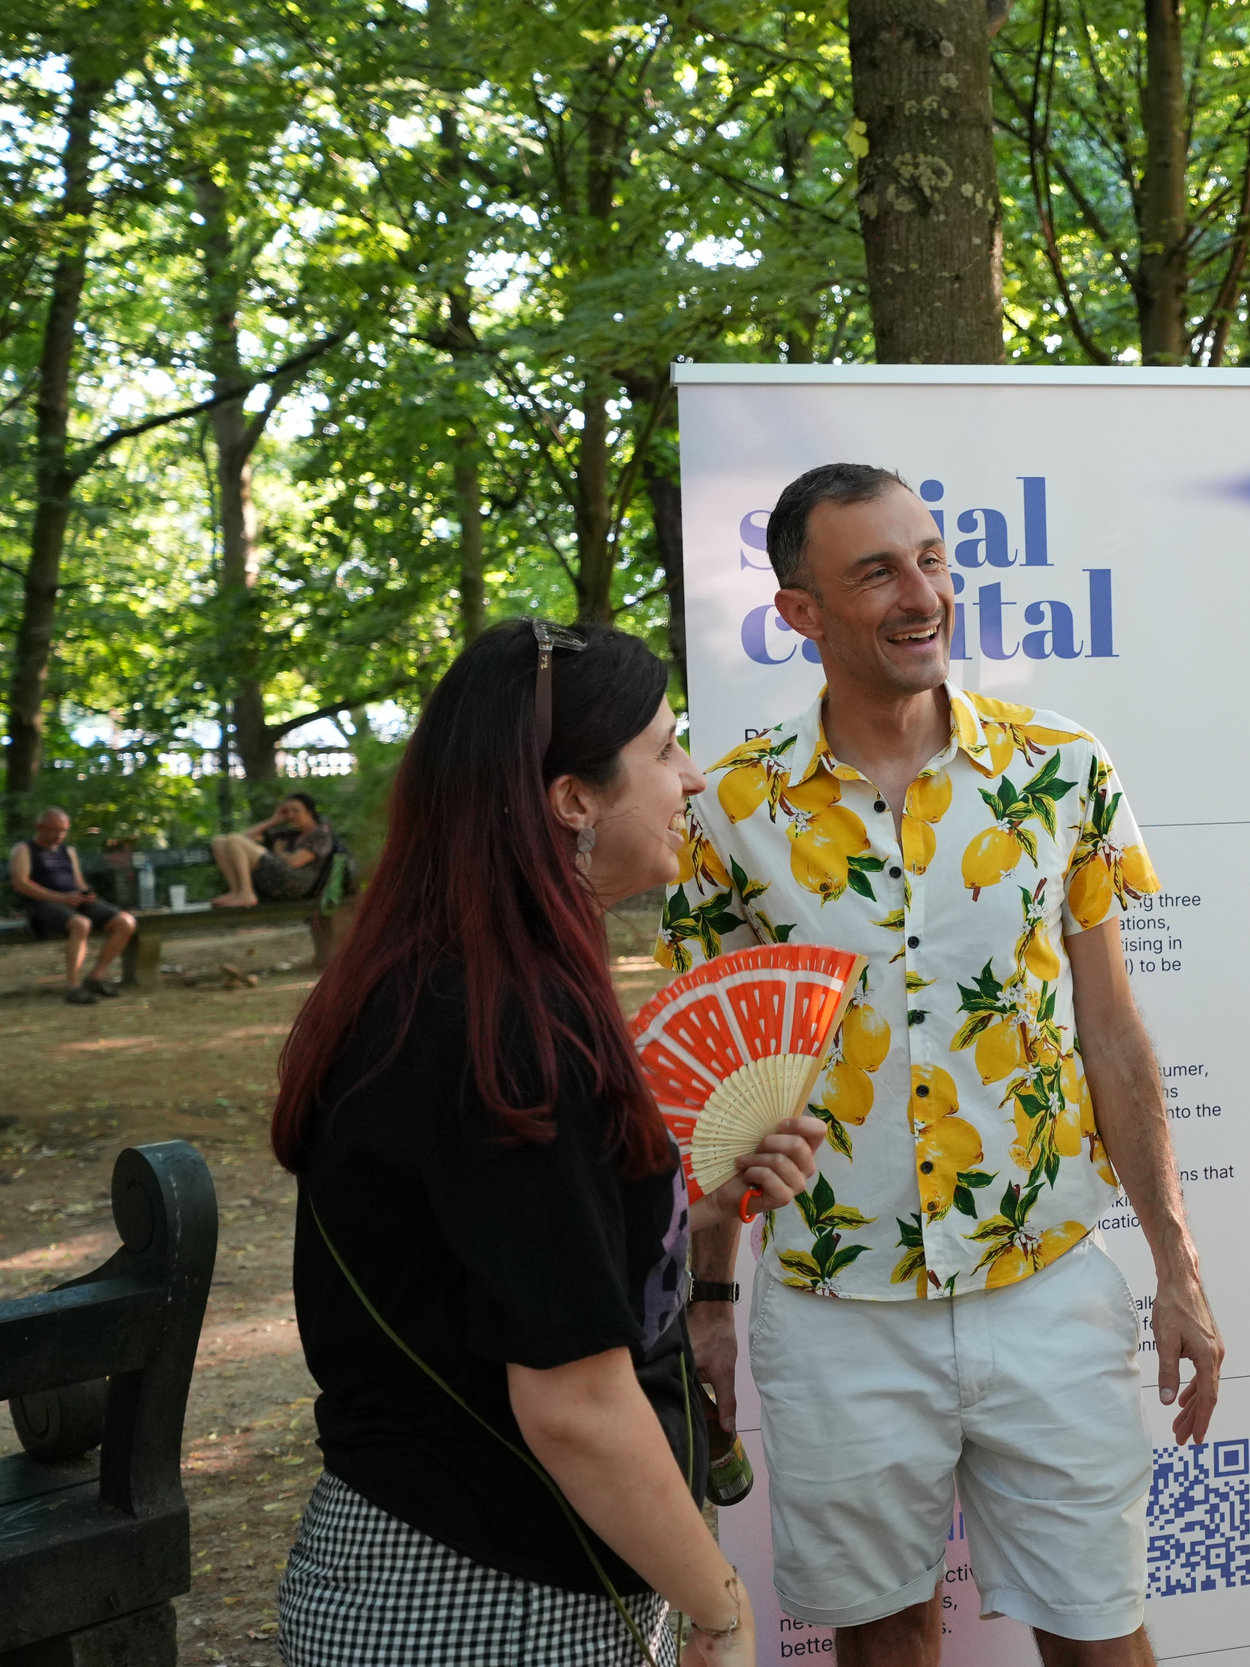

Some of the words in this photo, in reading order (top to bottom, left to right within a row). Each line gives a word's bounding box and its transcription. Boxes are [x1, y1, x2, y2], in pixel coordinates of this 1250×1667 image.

[739, 476, 1054, 569] sial
[740, 568, 1120, 665] cital
[1159, 894, 1201, 908] three
[1119, 916, 1170, 931] ations,
[1122, 937, 1163, 954] ising
[1168, 935, 1182, 950] in
[1140, 960, 1156, 973] to
[1161, 958, 1181, 972] be
[1159, 1064, 1209, 1078] umer,
[1167, 1105, 1191, 1119] nto
[1196, 1104, 1221, 1118] the
[1180, 1170, 1198, 1181] ns
[1203, 1165, 1234, 1180] that
[1098, 1214, 1140, 1230] catio
[781, 1637, 833, 1658] bette
